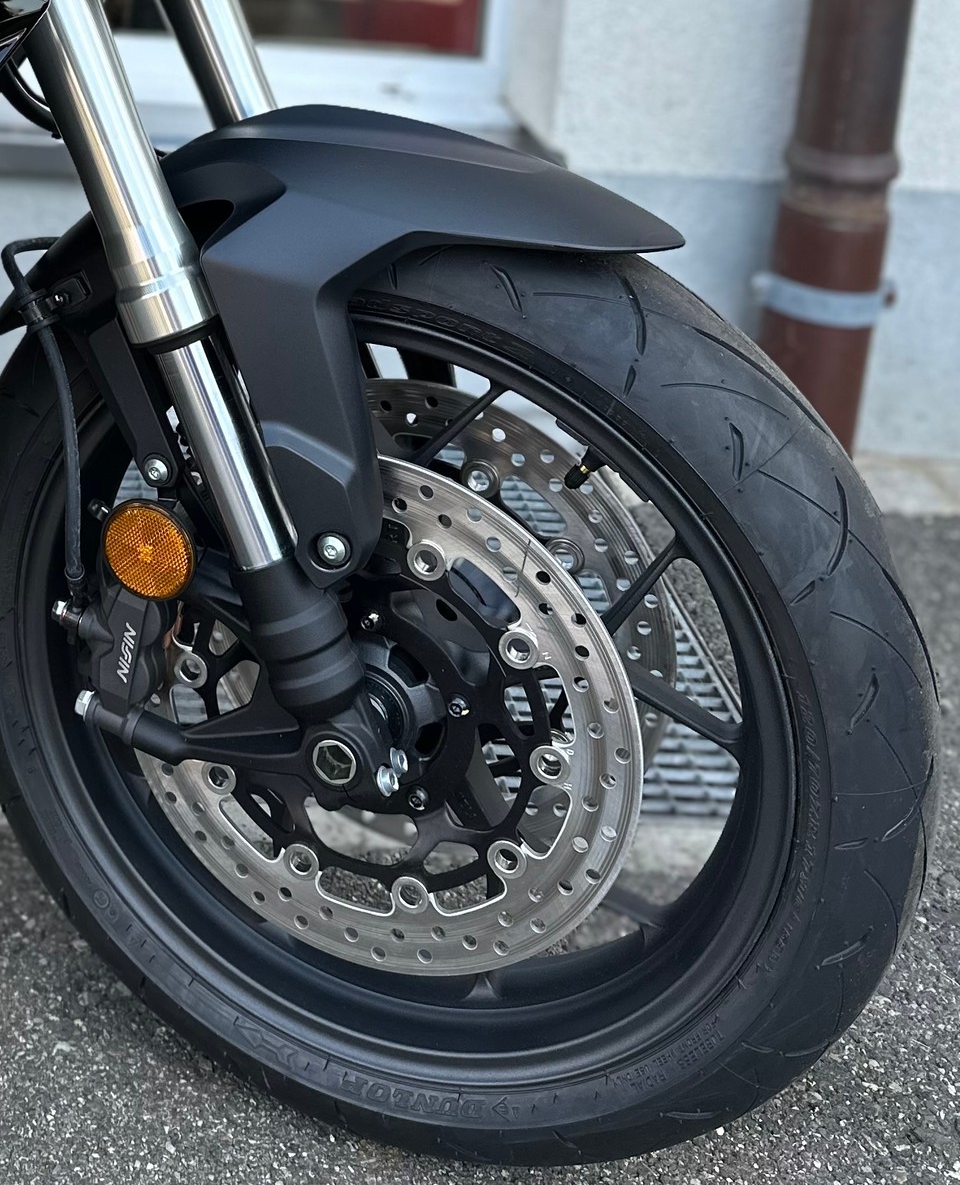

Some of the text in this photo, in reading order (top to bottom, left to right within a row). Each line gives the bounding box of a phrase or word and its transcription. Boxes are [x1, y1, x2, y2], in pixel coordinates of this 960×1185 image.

[116, 621, 137, 684] NISSIN
[630, 1030, 724, 1093] TUBELESS RADIAL
[342, 1073, 488, 1119] DUNLOP
